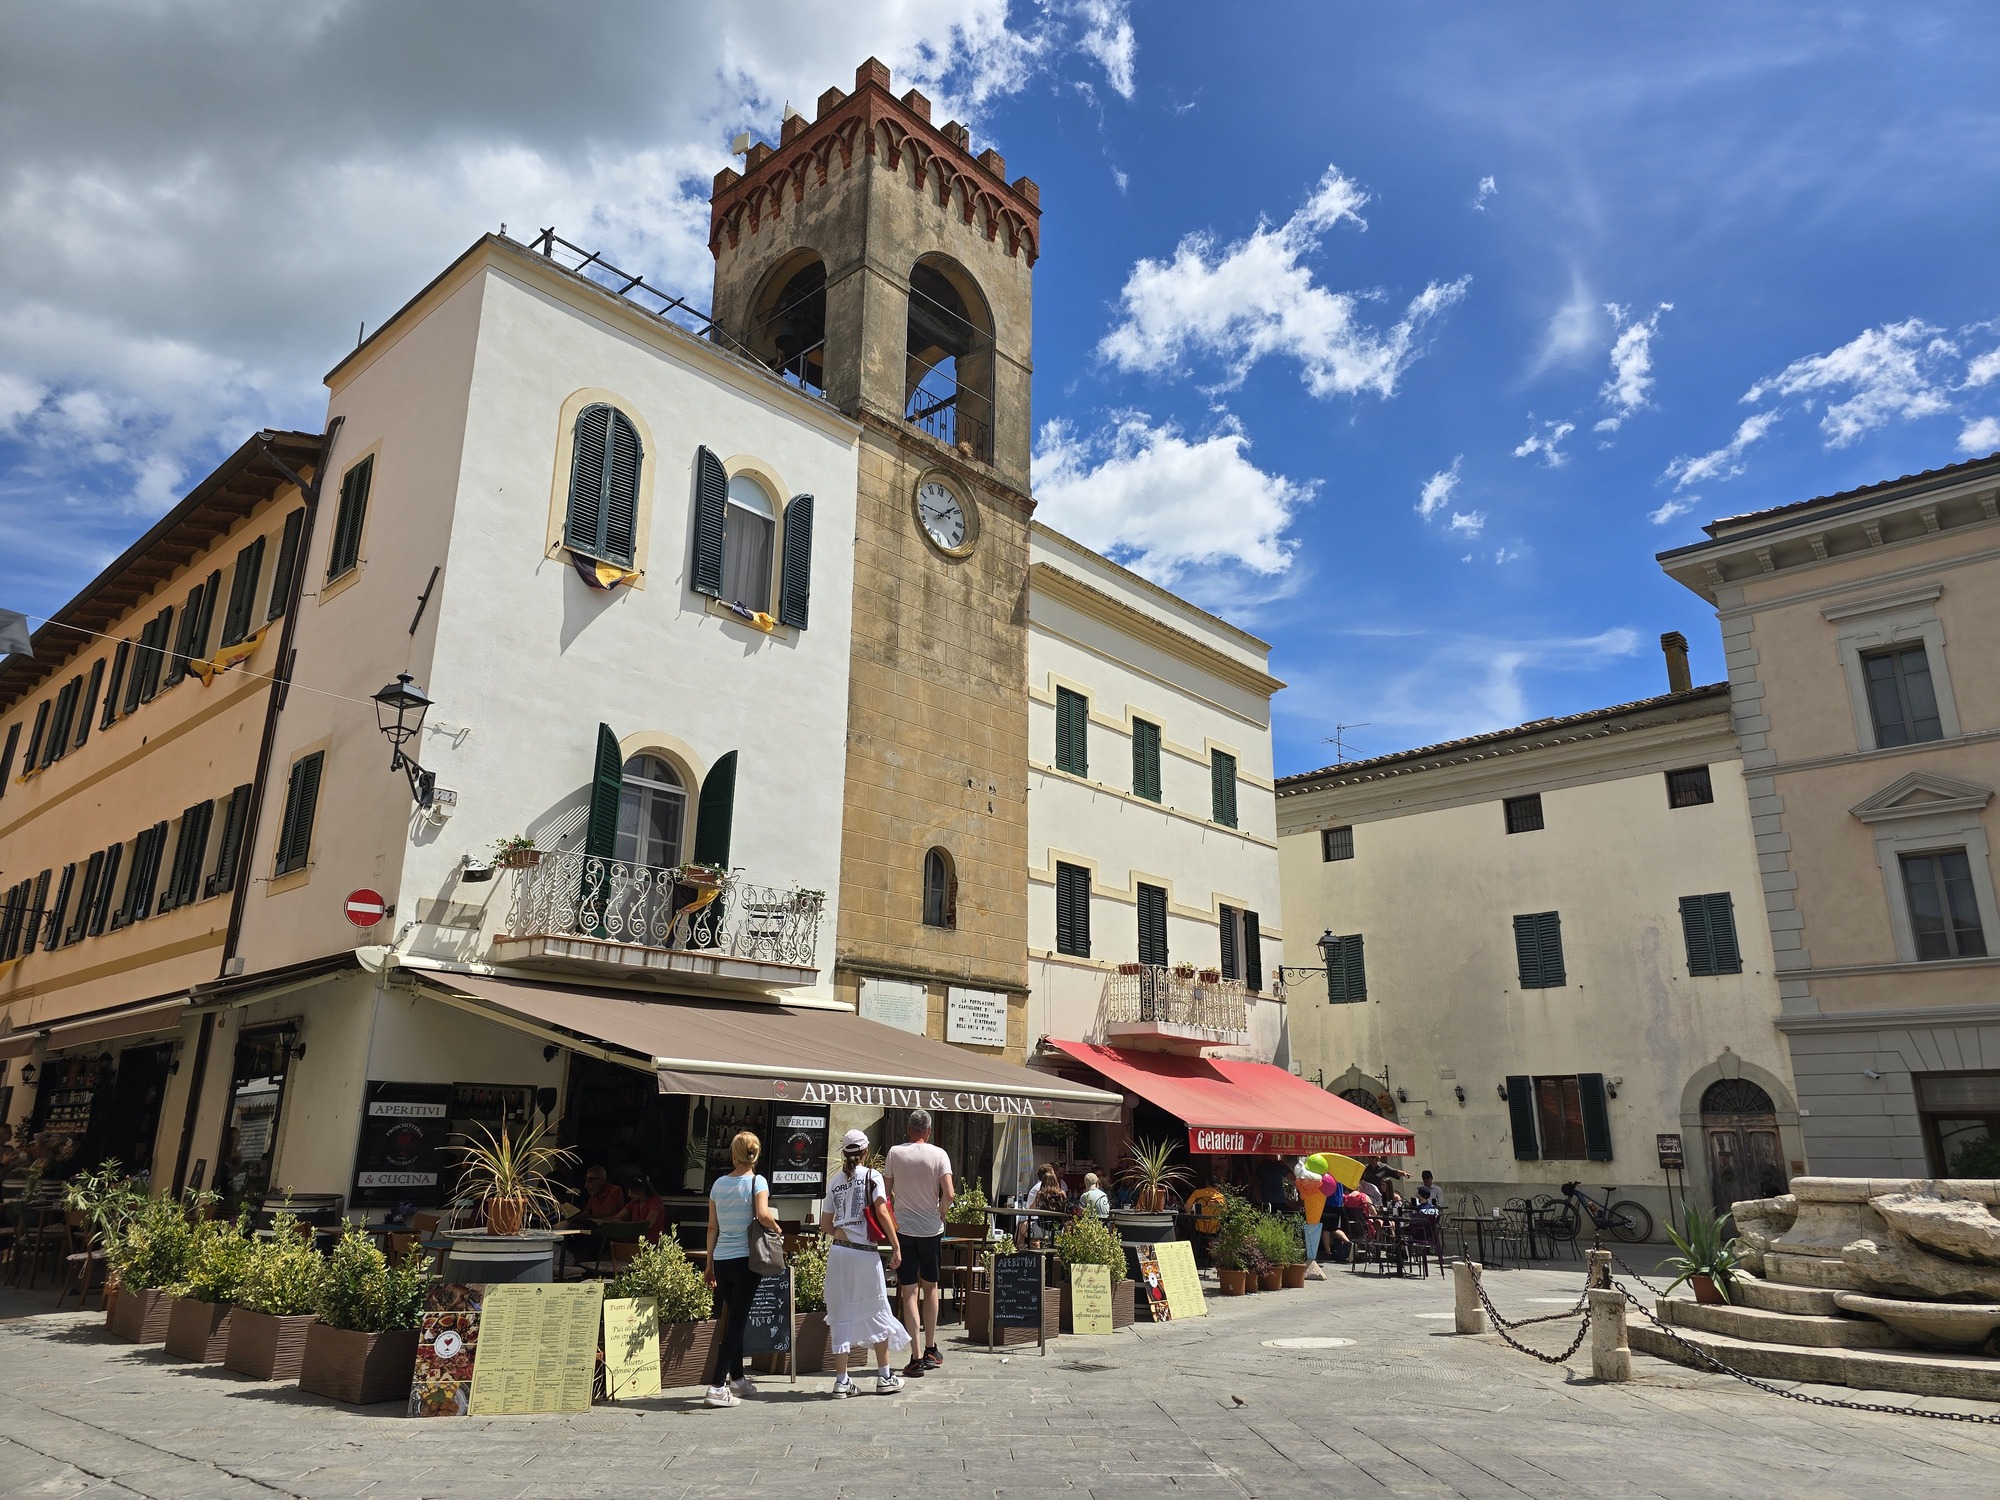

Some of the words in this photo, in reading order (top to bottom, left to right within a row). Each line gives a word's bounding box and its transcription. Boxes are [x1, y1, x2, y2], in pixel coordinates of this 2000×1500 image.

[800, 1082, 922, 1108] APERITIVI
[929, 1091, 949, 1110] &
[954, 1092, 1036, 1116] CUCINA
[375, 1105, 440, 1116] APERITIVI
[780, 1118, 822, 1127] APERITIVI
[386, 1122, 424, 1138] PROSCIUTTERIA
[1197, 1130, 1245, 1151] Gelateria
[1270, 1133, 1295, 1148] BAR
[1301, 1134, 1353, 1150] CENTRALE
[1369, 1137, 1384, 1154] Food
[1384, 1138, 1391, 1153] &
[1391, 1137, 1408, 1154] Drink
[364, 1174, 375, 1184] &
[378, 1174, 431, 1184] CUCINA
[775, 1174, 783, 1182] &
[784, 1173, 819, 1182] CUCINA
[997, 1256, 1036, 1268] APERITIVI
